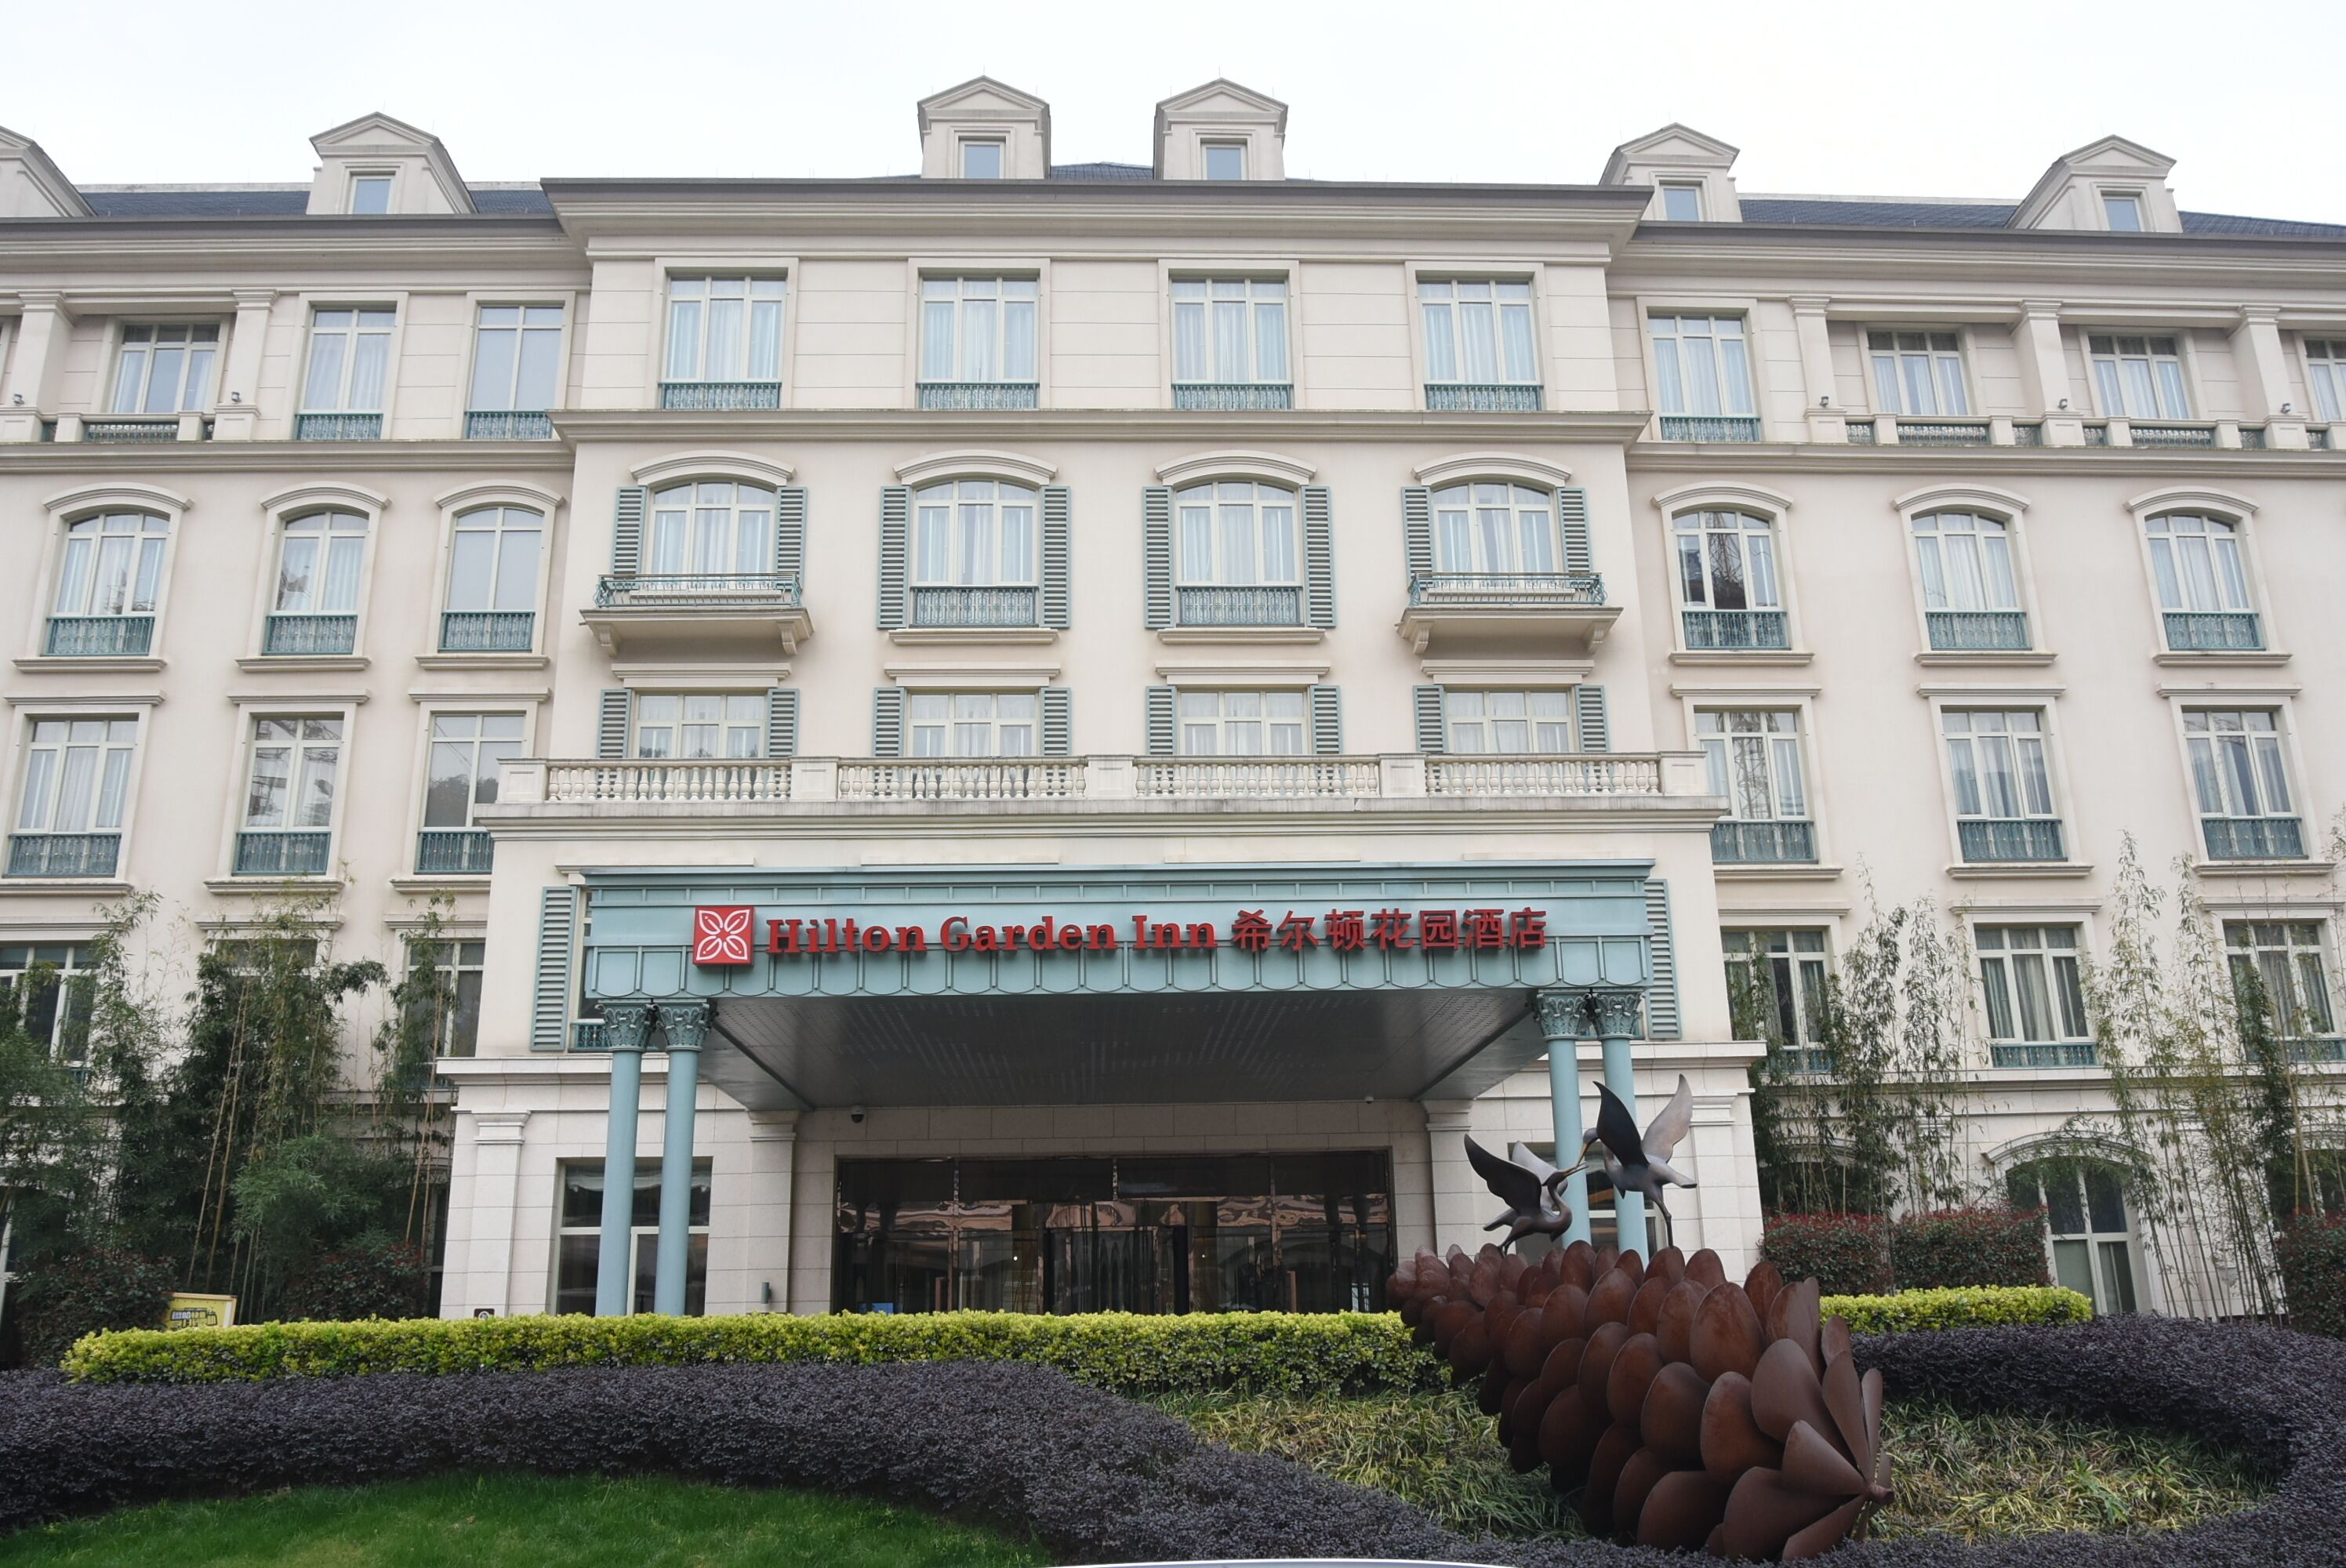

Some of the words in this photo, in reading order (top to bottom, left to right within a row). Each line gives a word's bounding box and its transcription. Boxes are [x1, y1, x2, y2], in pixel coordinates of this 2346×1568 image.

[766, 917, 928, 953] Hilton
[940, 916, 1118, 951] Garden
[1132, 915, 1218, 949] Inn
[1232, 907, 1548, 952] 希尔顿花园酒店
